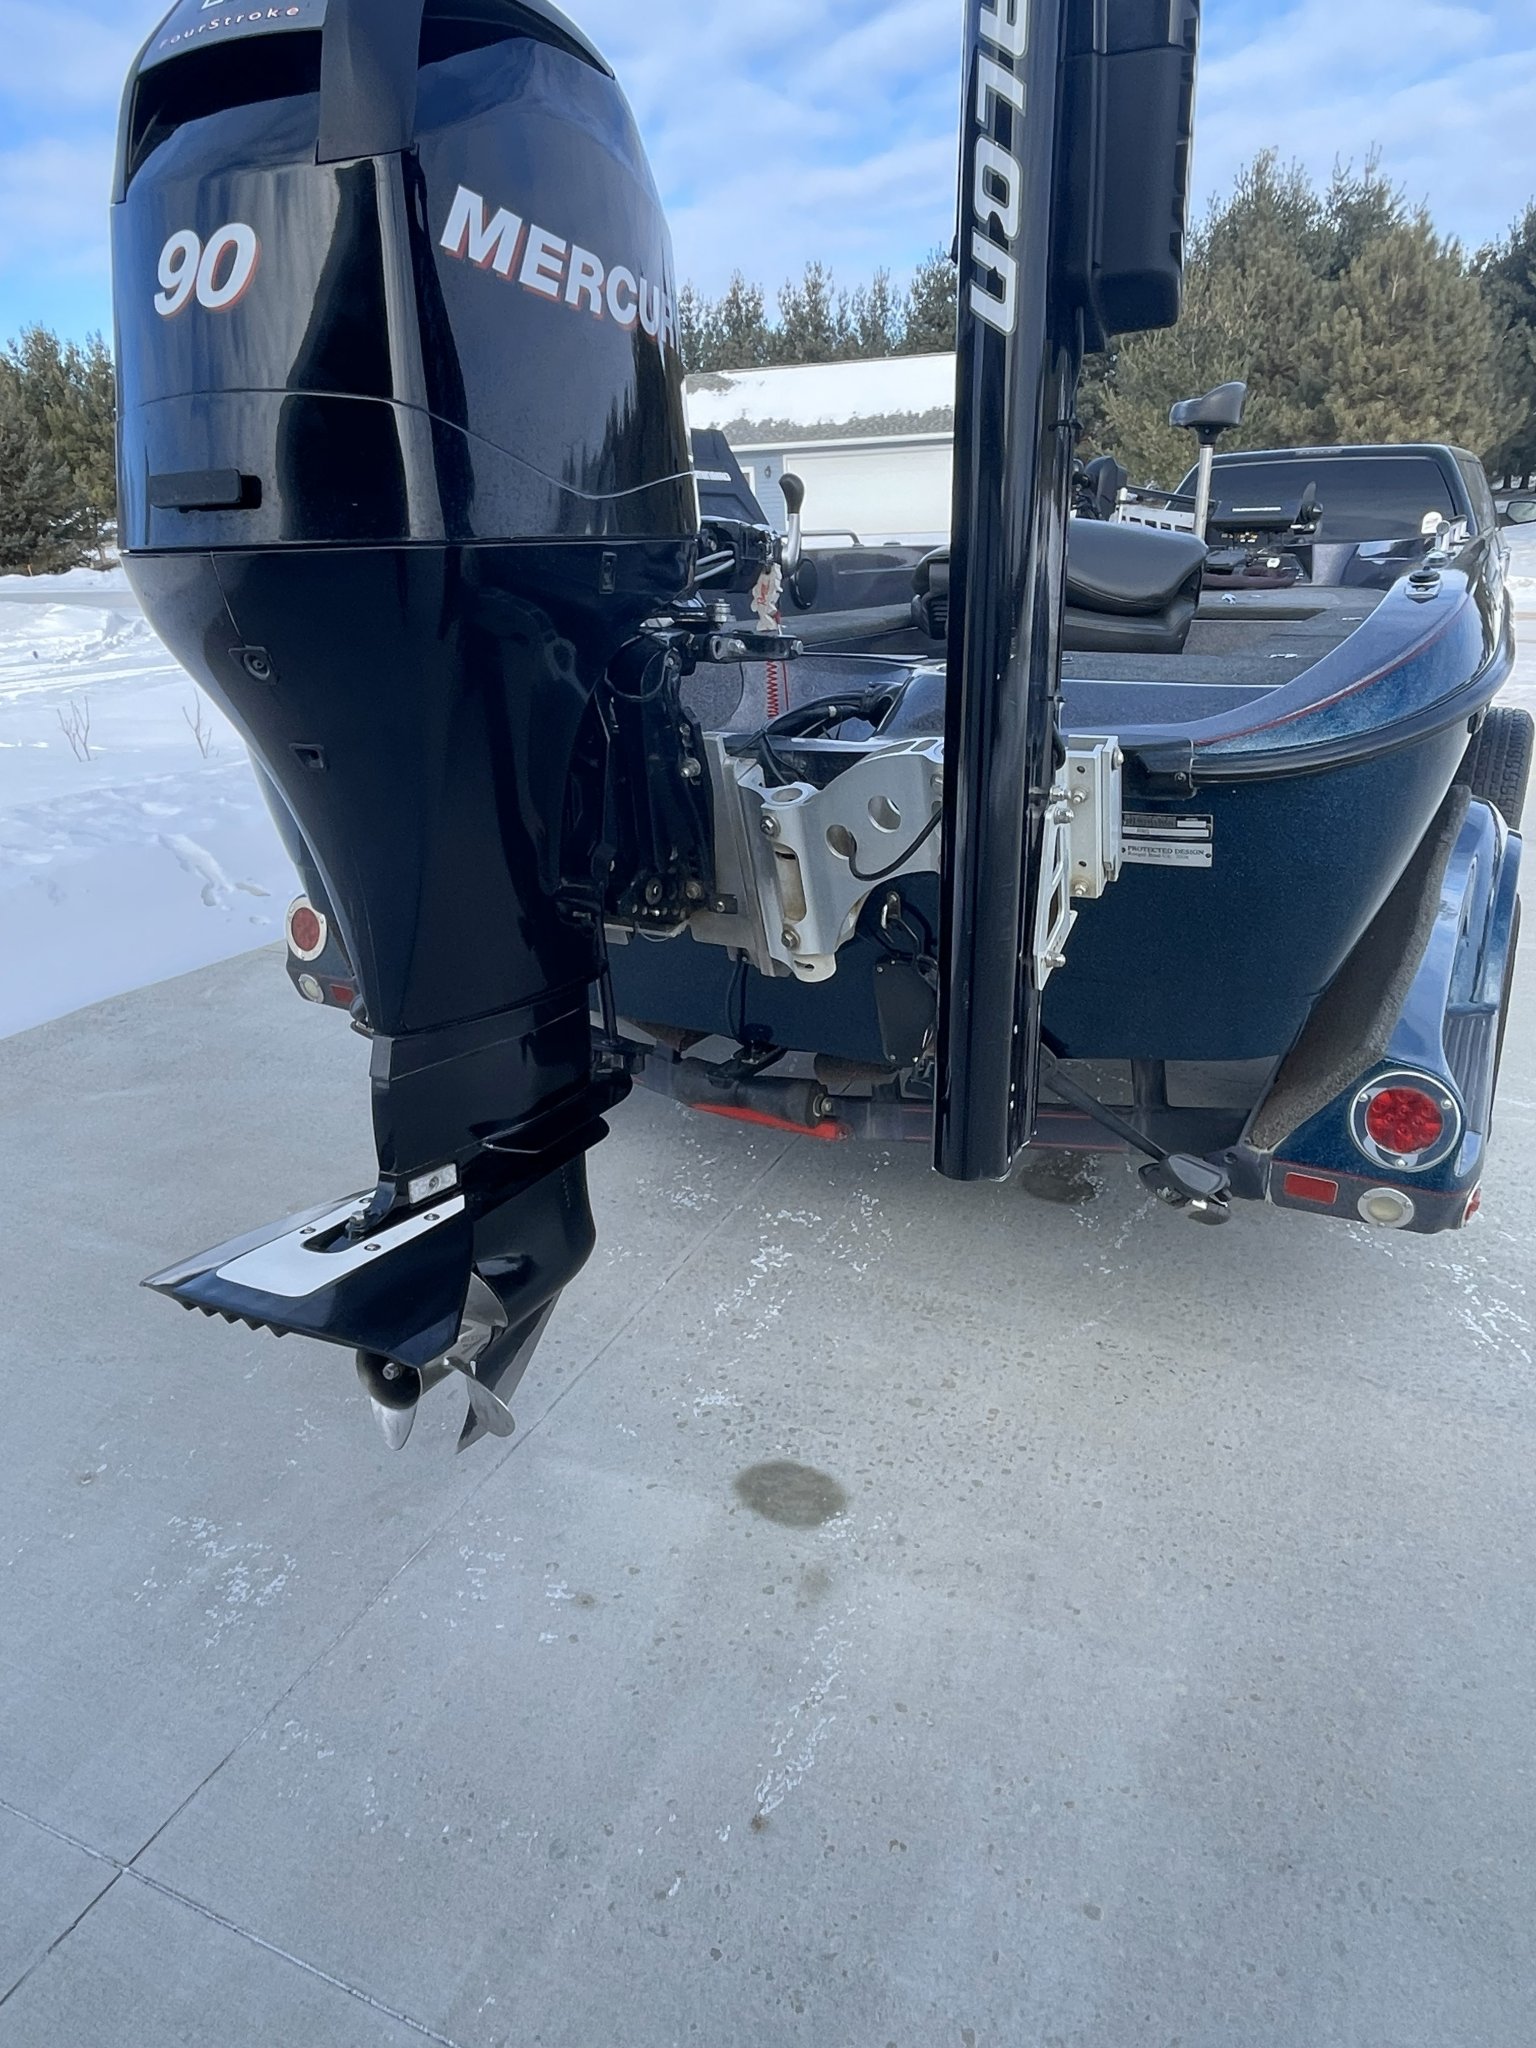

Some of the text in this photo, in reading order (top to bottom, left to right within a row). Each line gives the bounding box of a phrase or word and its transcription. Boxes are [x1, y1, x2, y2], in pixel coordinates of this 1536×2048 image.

[153, 222, 262, 319] 90
[1127, 845, 1173, 854] PROTECTED
[1174, 847, 1204, 855] DESIGN
